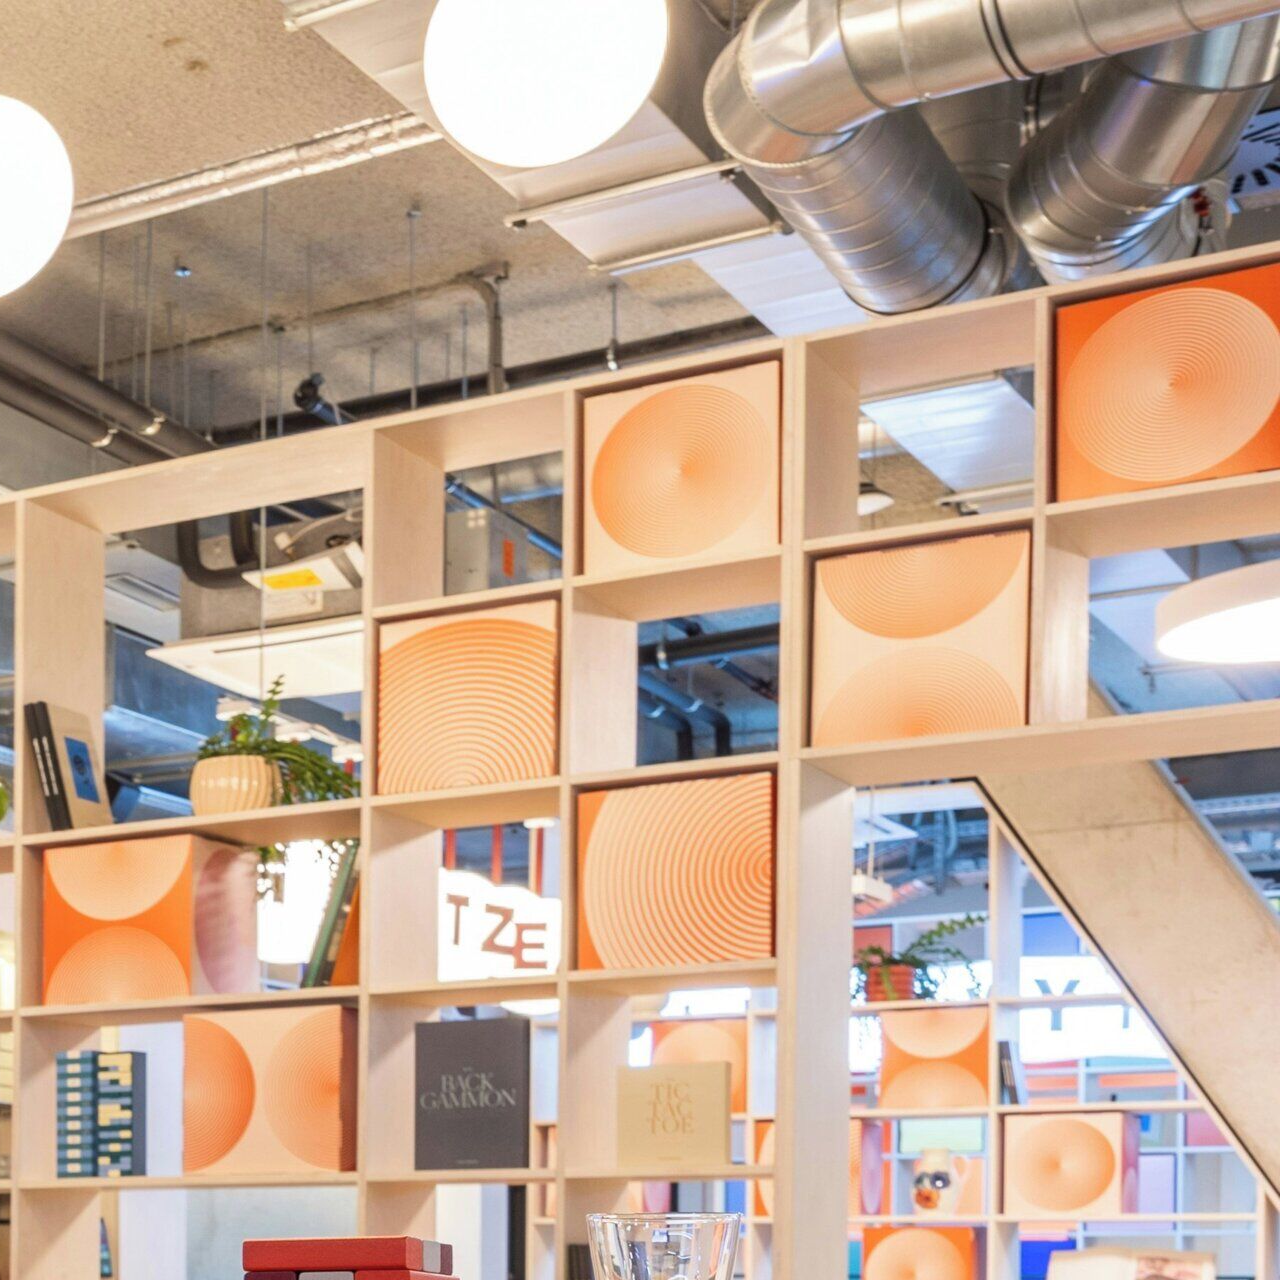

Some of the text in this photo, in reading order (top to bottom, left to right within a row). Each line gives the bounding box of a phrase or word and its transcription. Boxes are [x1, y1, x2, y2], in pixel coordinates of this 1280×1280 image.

[441, 1072, 496, 1092] BACK
[650, 1083, 690, 1101] TIC
[419, 1088, 517, 1110] GAMMON
[647, 1099, 694, 1121] TAC
[646, 1117, 695, 1136] TOE
